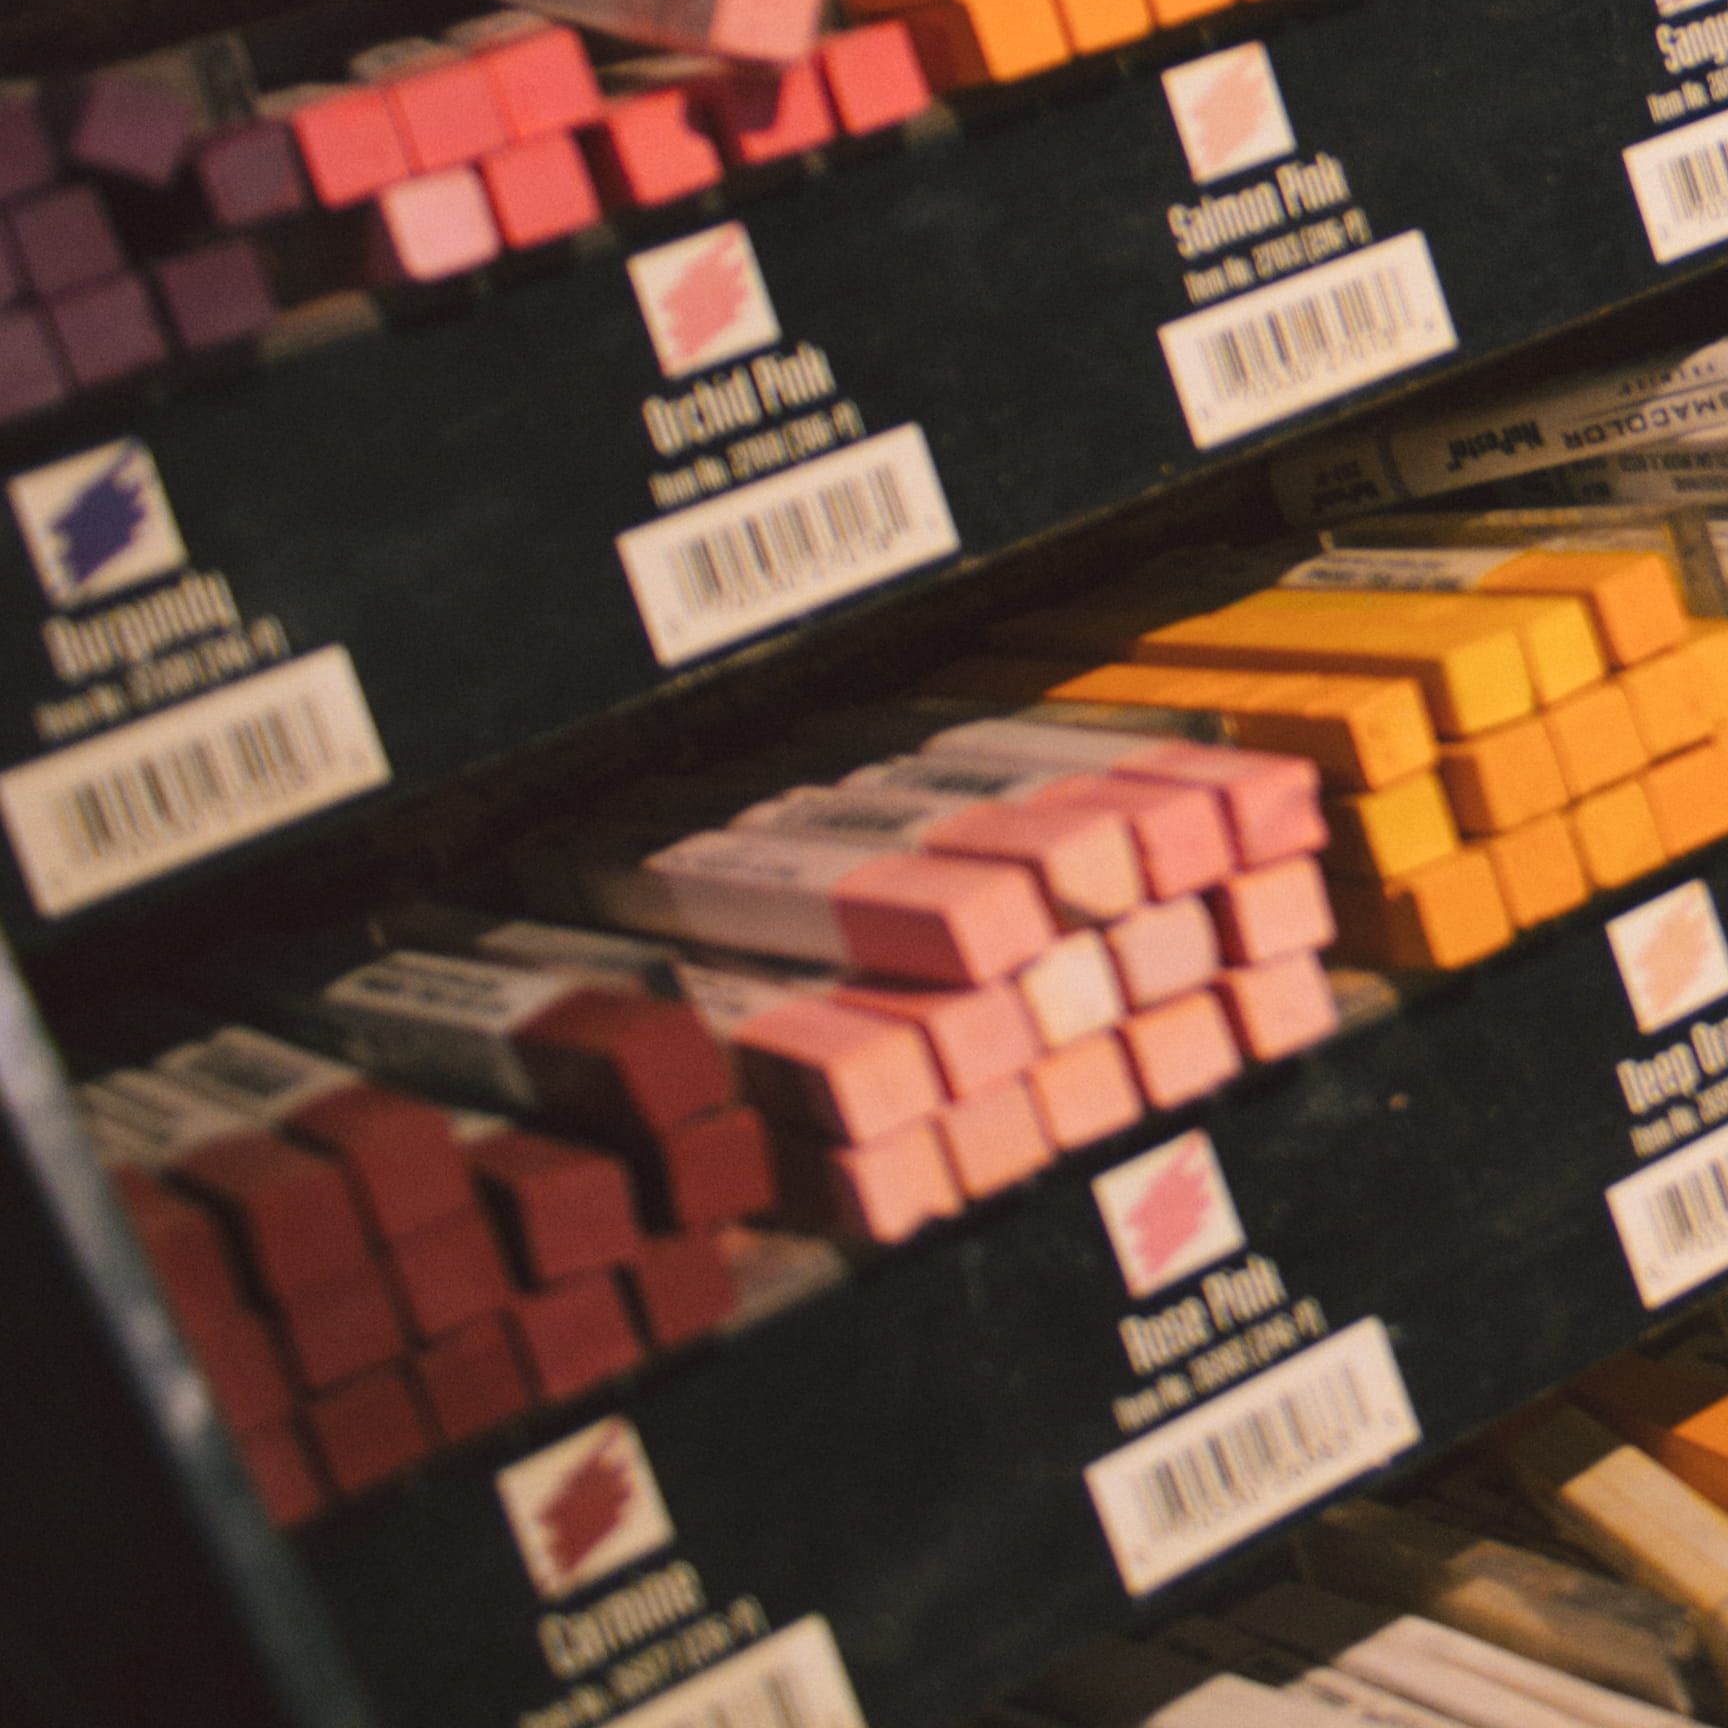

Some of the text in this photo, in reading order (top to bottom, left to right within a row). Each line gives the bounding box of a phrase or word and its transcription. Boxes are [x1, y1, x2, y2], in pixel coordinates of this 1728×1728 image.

[1168, 154, 1348, 257] Salmon Pink
[643, 370, 760, 453] Orchid
[752, 346, 834, 411] Pink
[1617, 1044, 1699, 1113] Deep
